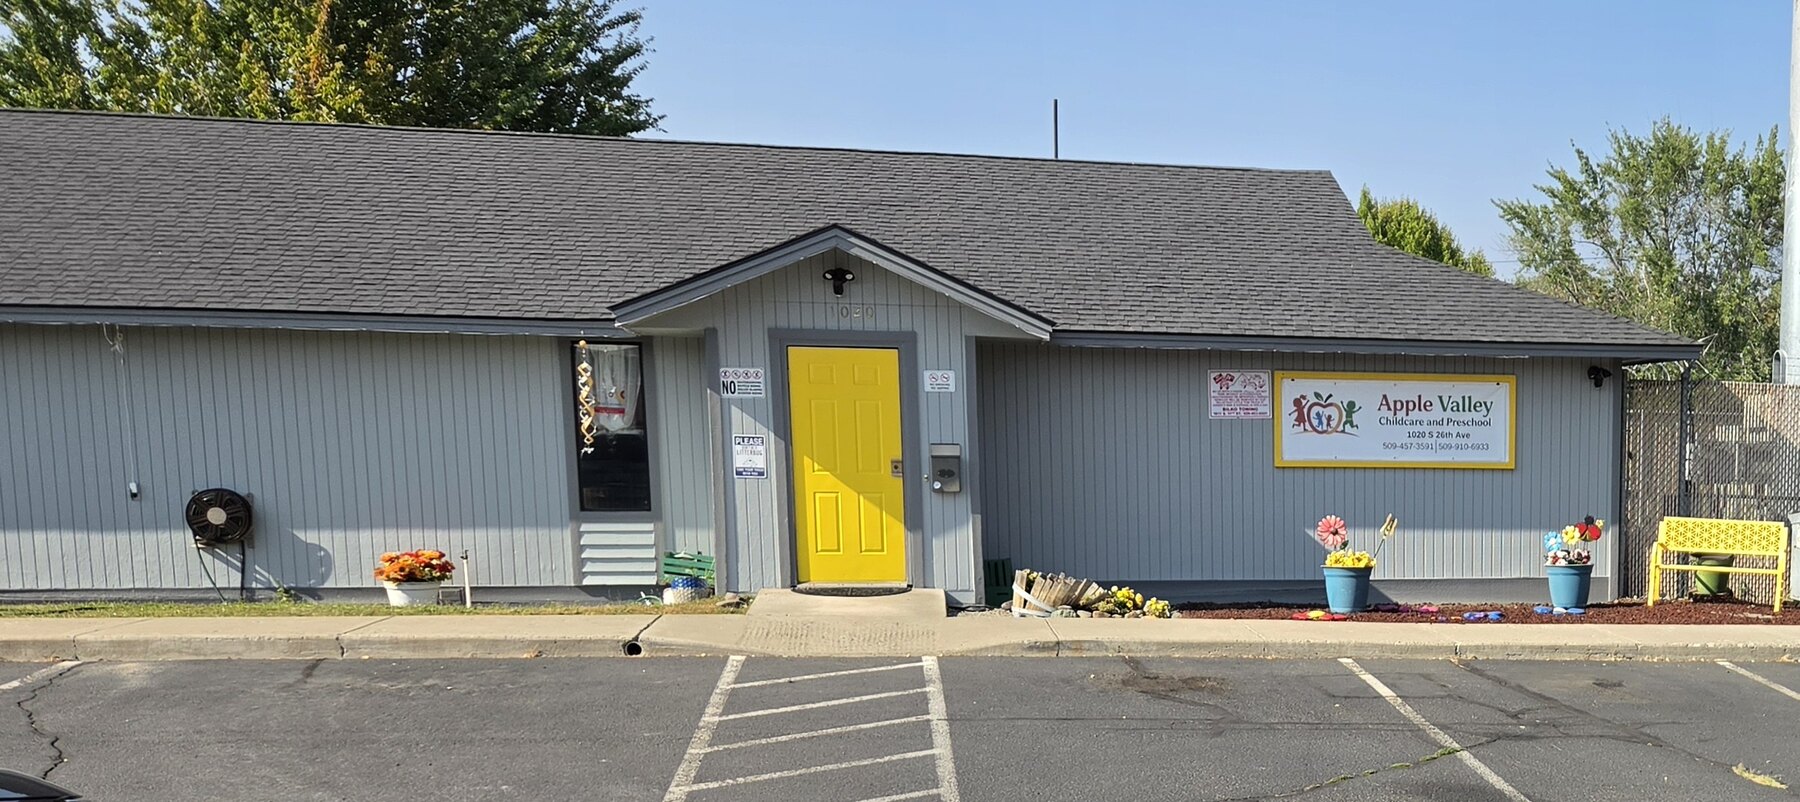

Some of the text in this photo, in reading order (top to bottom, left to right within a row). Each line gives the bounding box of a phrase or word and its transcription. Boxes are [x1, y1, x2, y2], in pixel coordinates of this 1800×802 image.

[721, 380, 736, 395] NO
[1377, 393, 1494, 418] Apple Valley
[1378, 416, 1492, 427] Childcare and Preschool
[1407, 430, 1471, 439] 1020 S 26th Ave
[735, 437, 763, 446] PLEASE
[1382, 441, 1490, 451] 509-457-3591 509-910-6933
